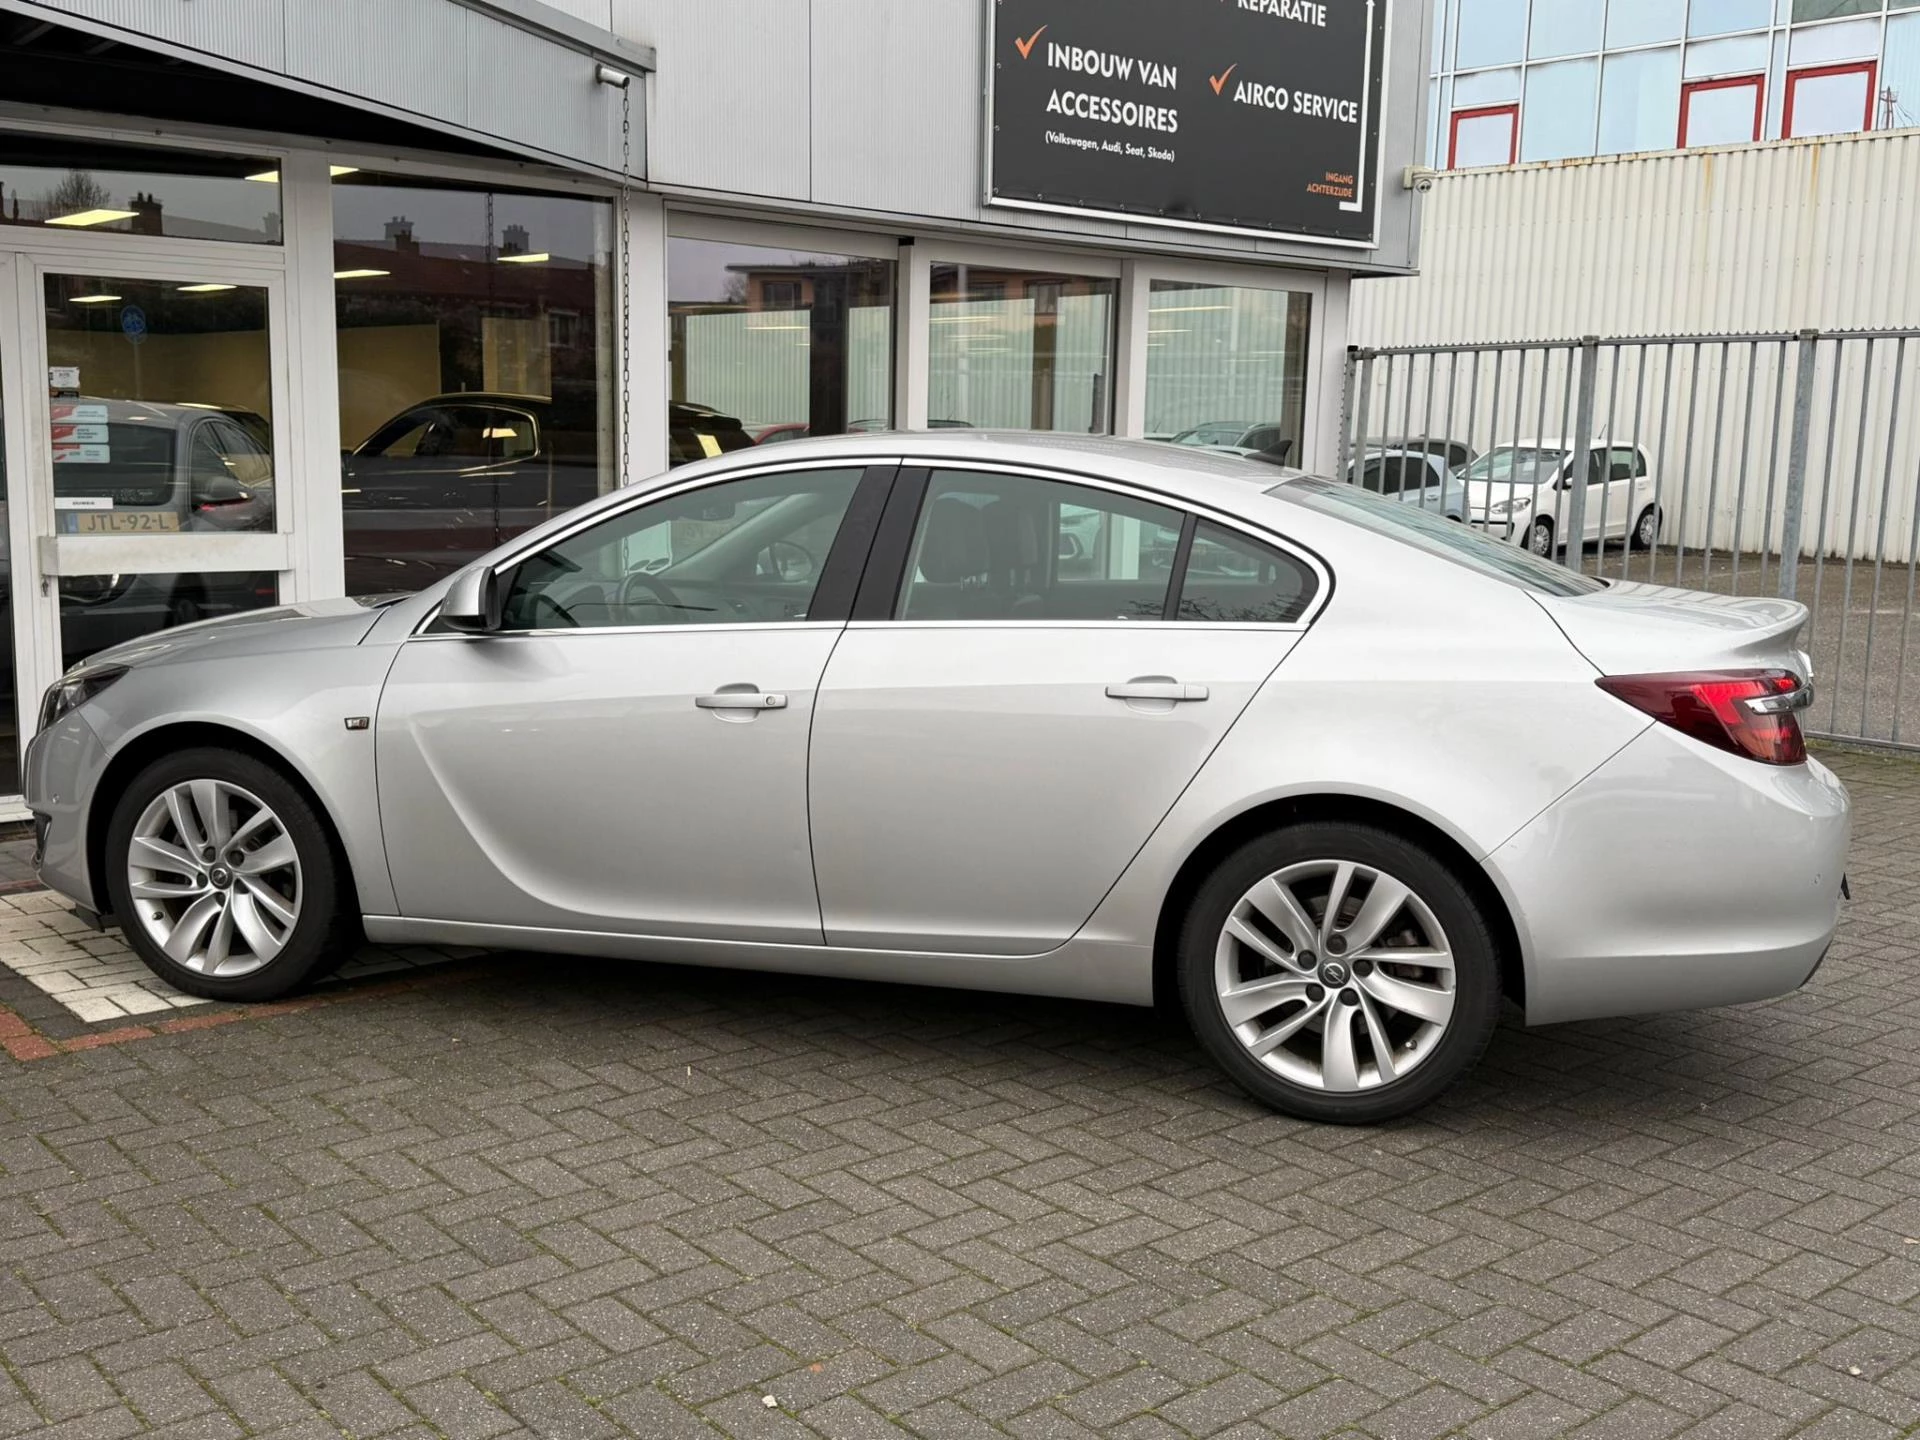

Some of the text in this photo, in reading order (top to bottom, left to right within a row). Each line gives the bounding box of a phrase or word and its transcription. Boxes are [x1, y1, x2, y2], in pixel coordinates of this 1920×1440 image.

[1047, 42, 1177, 90] INBOUW VAN
[1046, 88, 1178, 133] ACCESSOIRES
[1233, 80, 1358, 123] AIRCO SERVICE
[1045, 130, 1175, 163] (Volkswagen, Audi, Seat, Skoda)
[1325, 171, 1353, 185] INGANG
[87, 514, 169, 531] JTL-92-L
